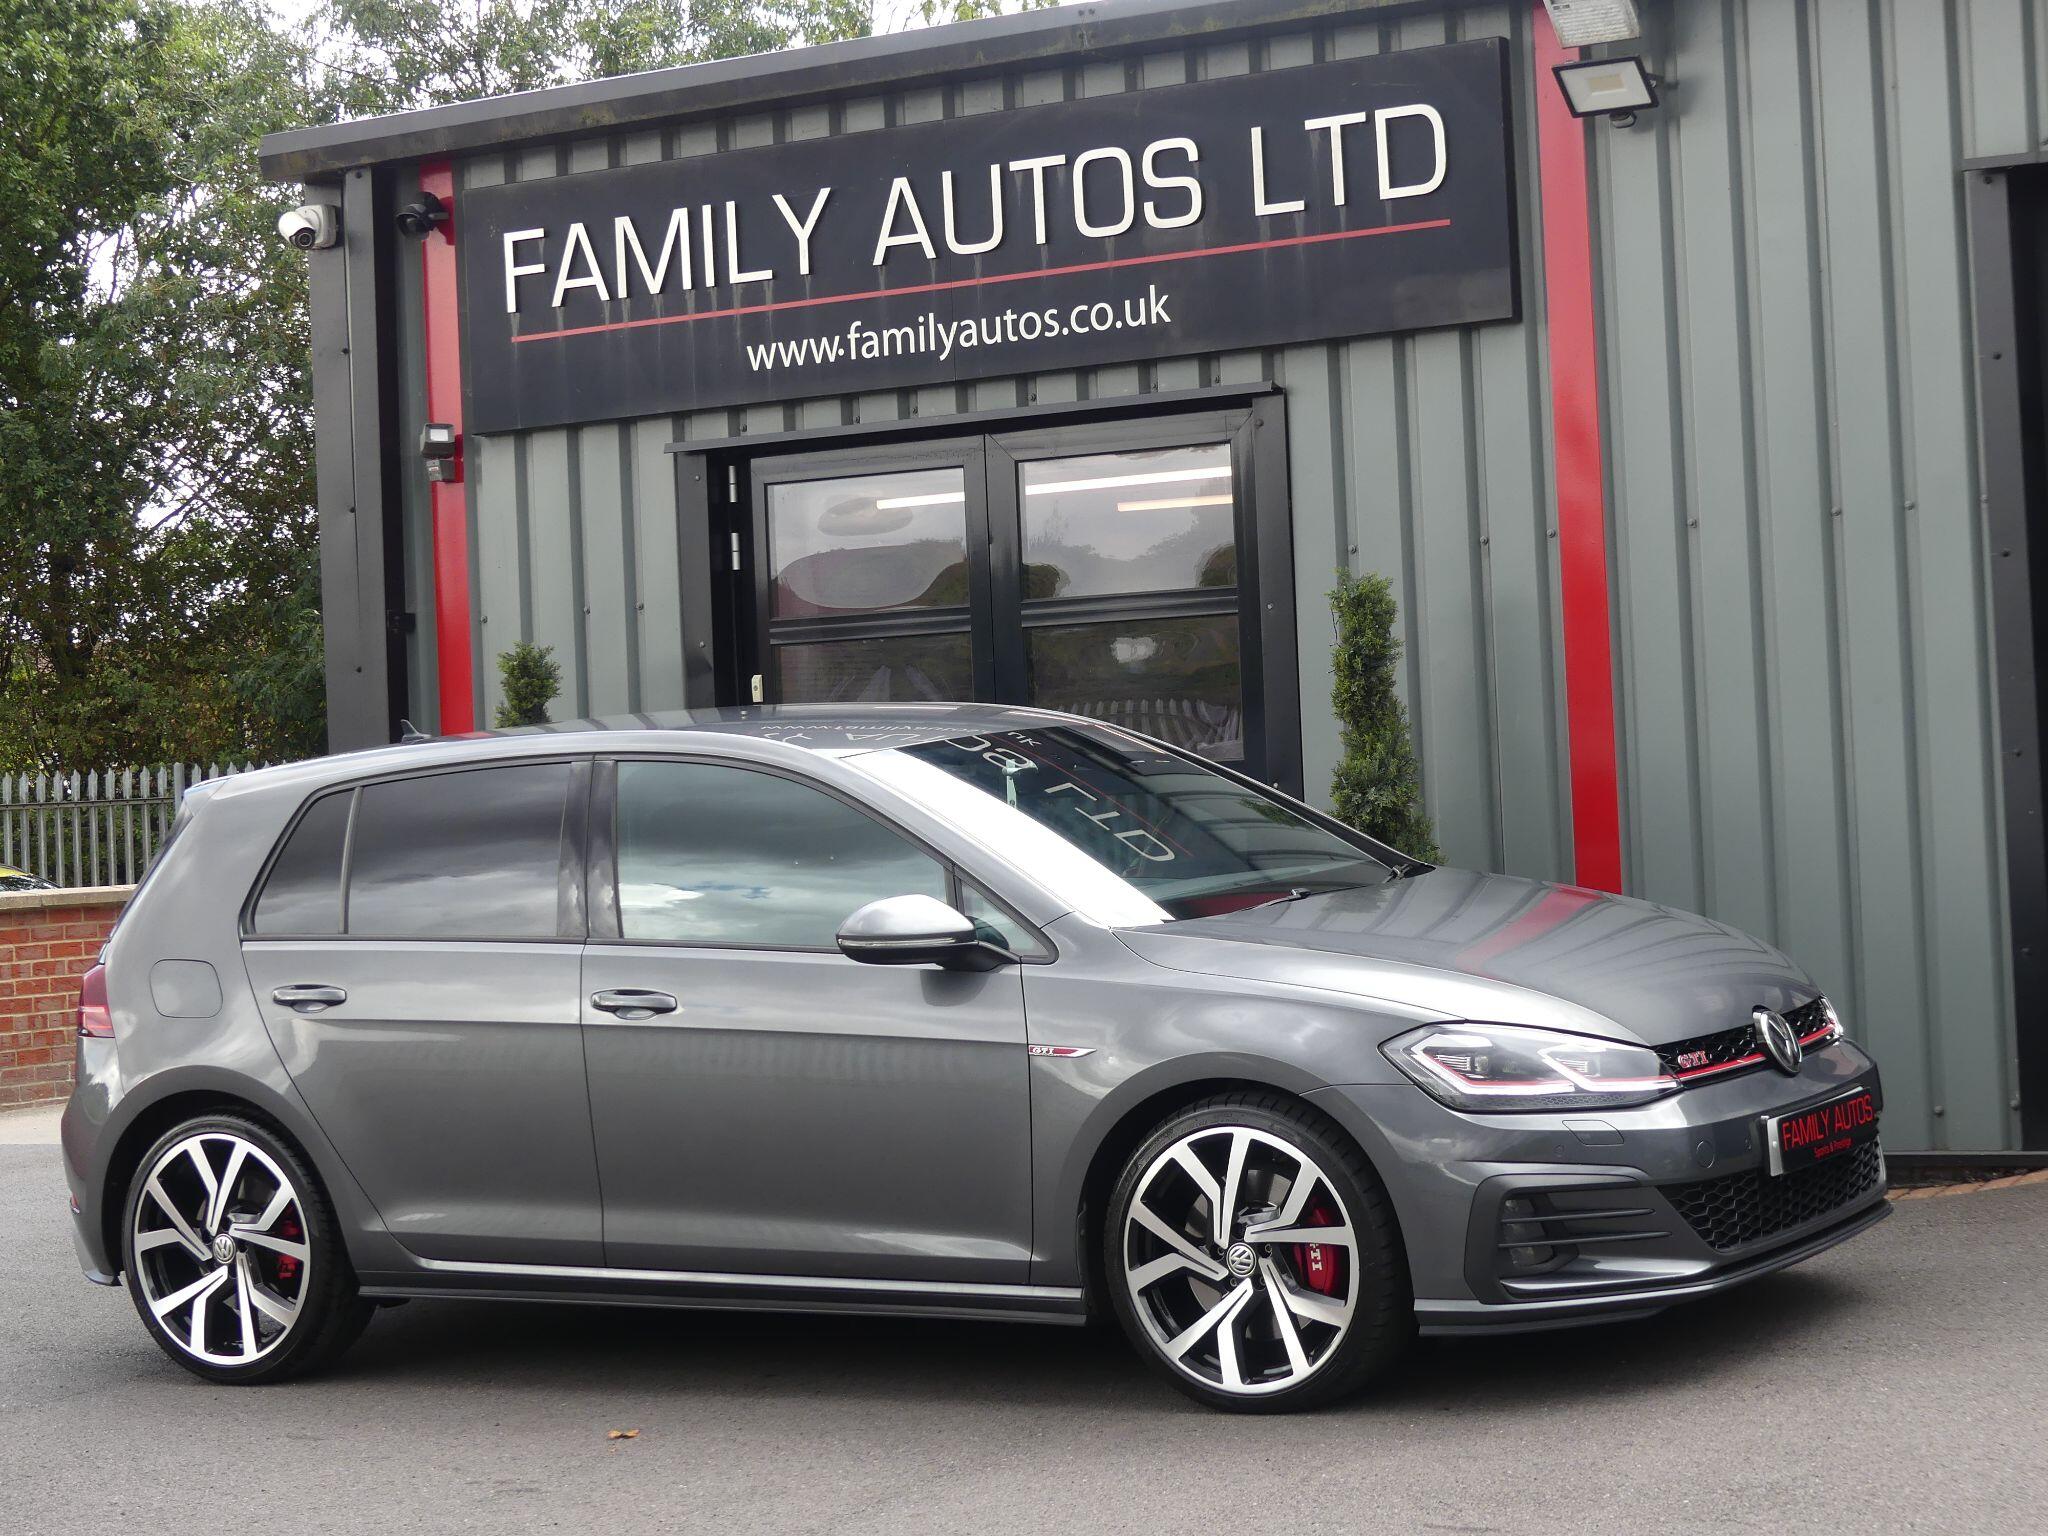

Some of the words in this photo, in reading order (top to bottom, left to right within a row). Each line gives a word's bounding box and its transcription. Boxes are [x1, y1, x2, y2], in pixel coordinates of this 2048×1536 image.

[503, 187, 831, 314] FAMILY
[873, 137, 1203, 267] AUTOS
[1251, 103, 1447, 217] LTD
[746, 284, 1172, 372] www.familyautos.co.uk
[1032, 1046, 1055, 1055] GTI
[1677, 1050, 1709, 1069] GTI
[1782, 1108, 1829, 1153] FAMILY
[1834, 1093, 1874, 1134] AUTOS
